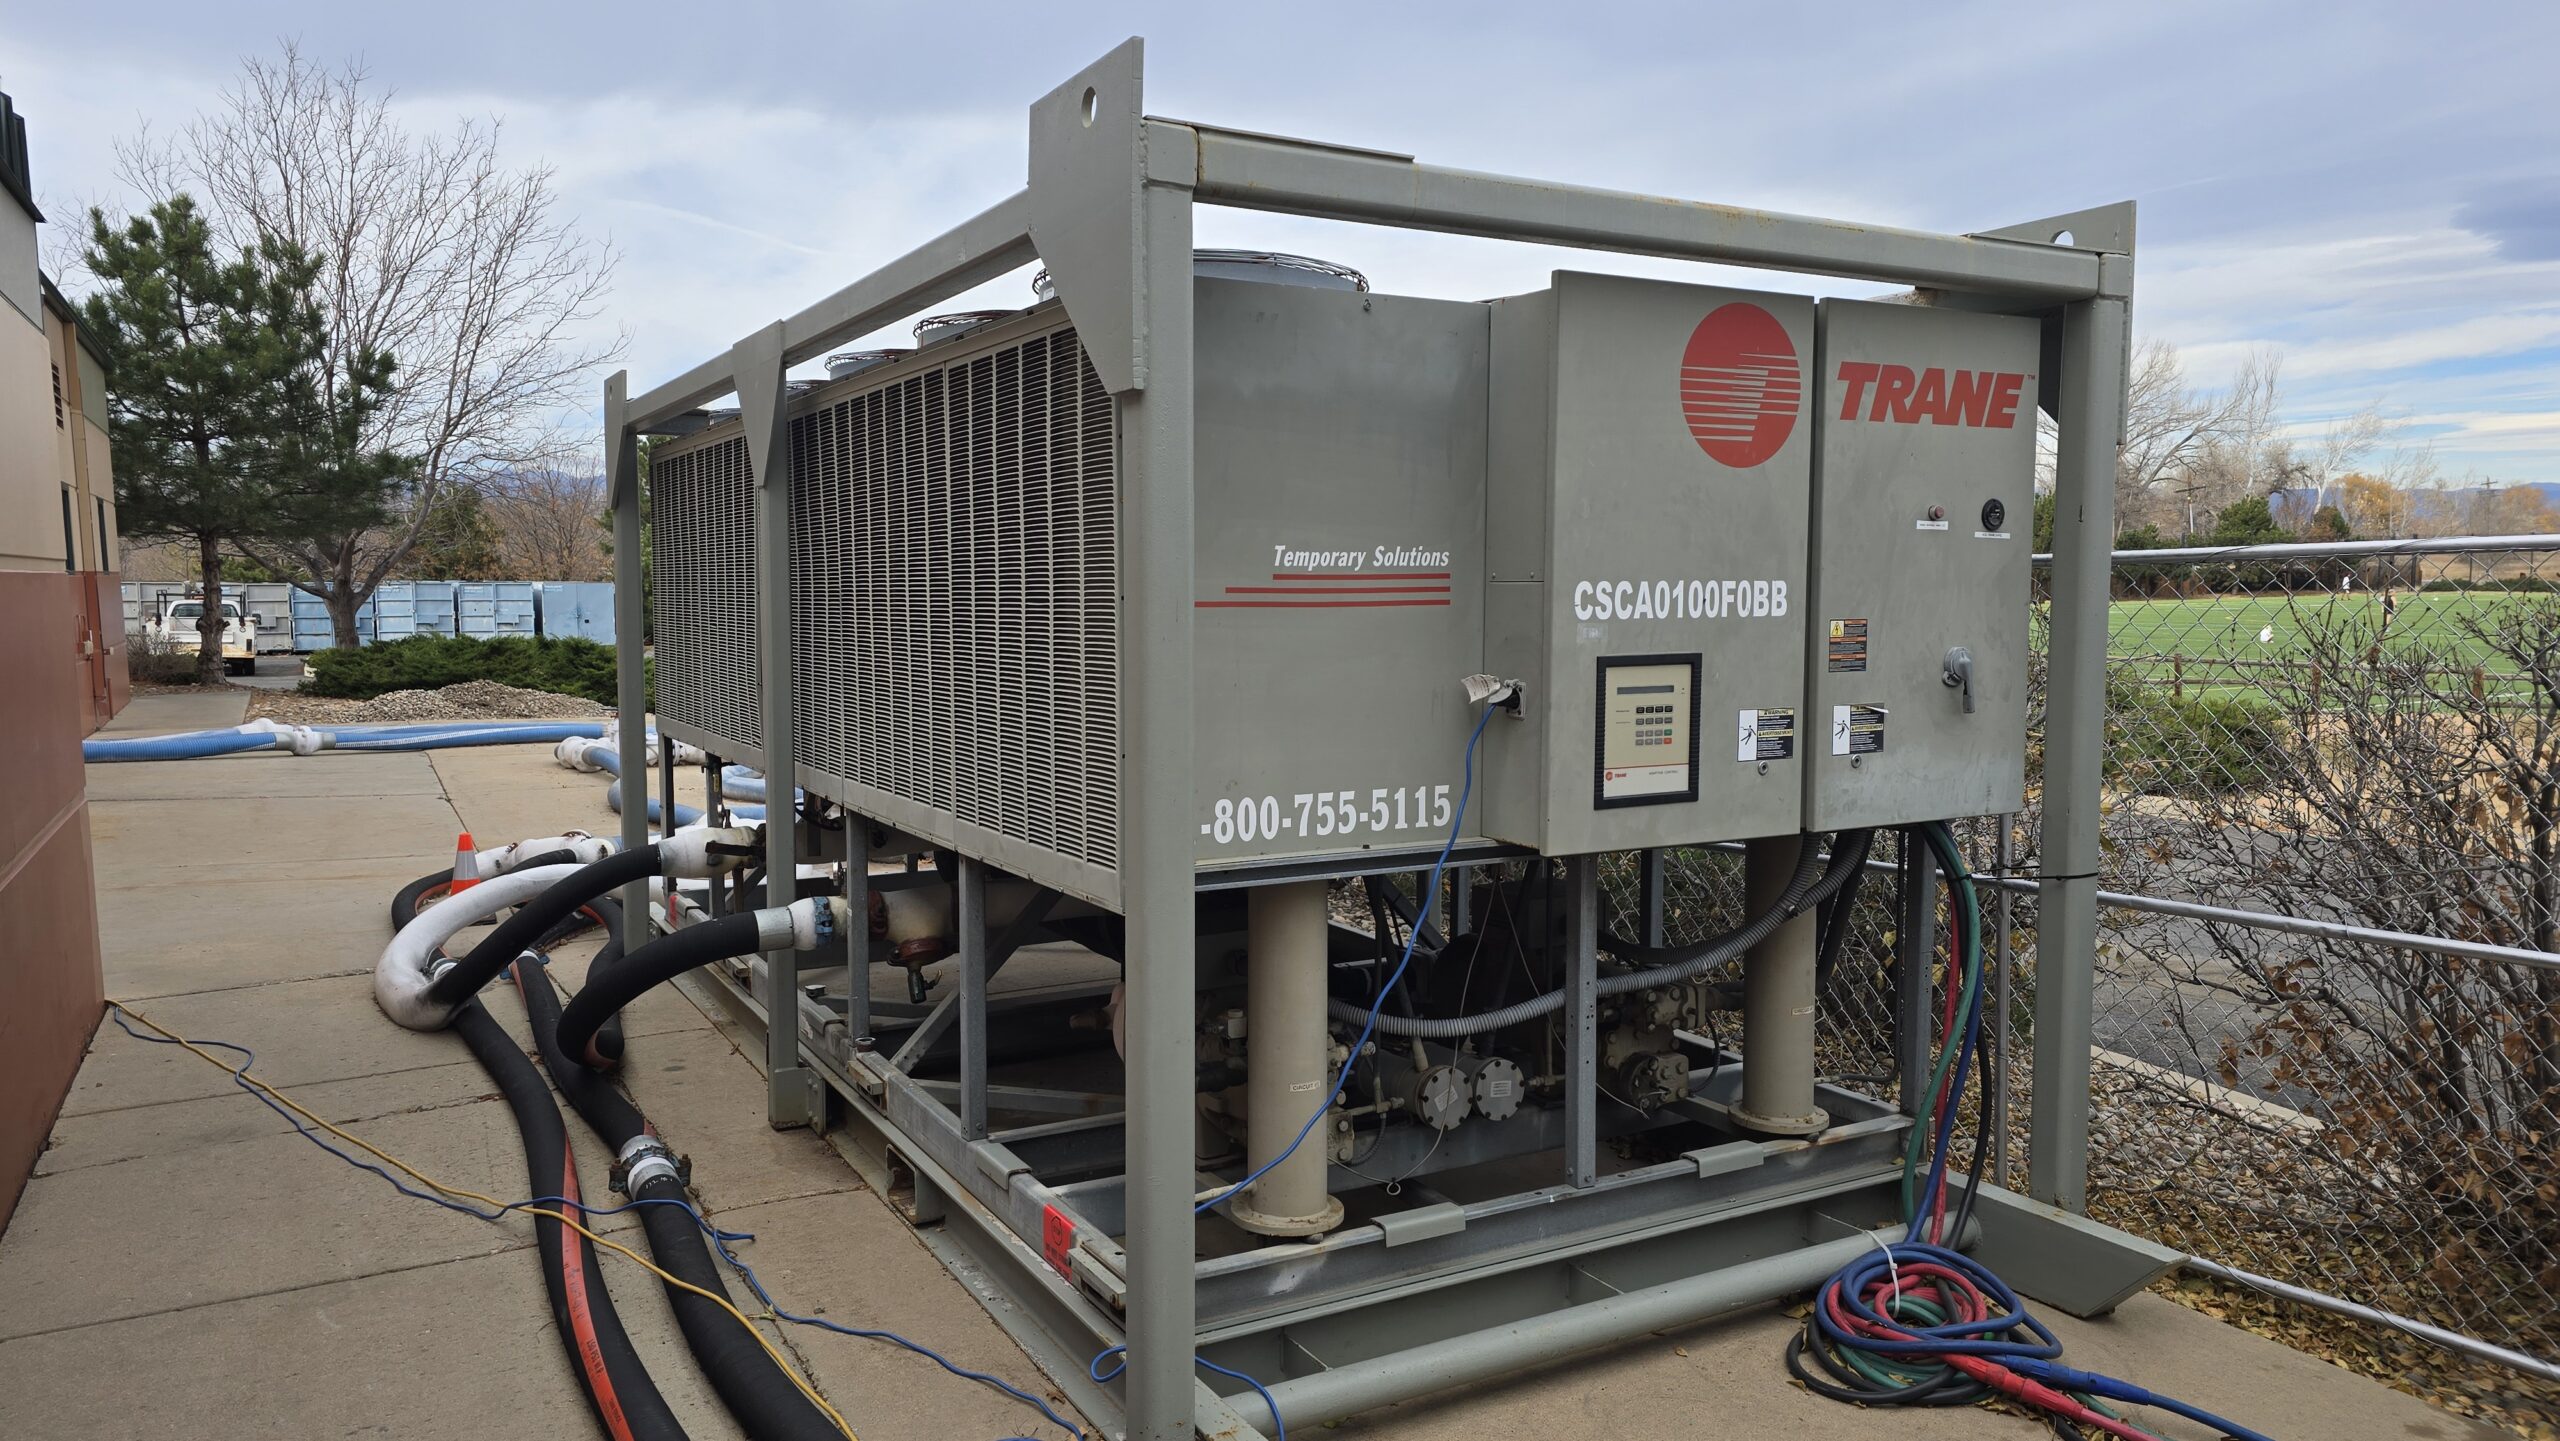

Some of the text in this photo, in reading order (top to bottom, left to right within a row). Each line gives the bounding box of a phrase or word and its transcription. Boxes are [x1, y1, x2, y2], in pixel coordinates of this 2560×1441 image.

[1837, 361, 2025, 429] TRANE
[1273, 545, 1450, 571] Temporary Solutions
[1201, 784, 1451, 844] -800-755-5115
